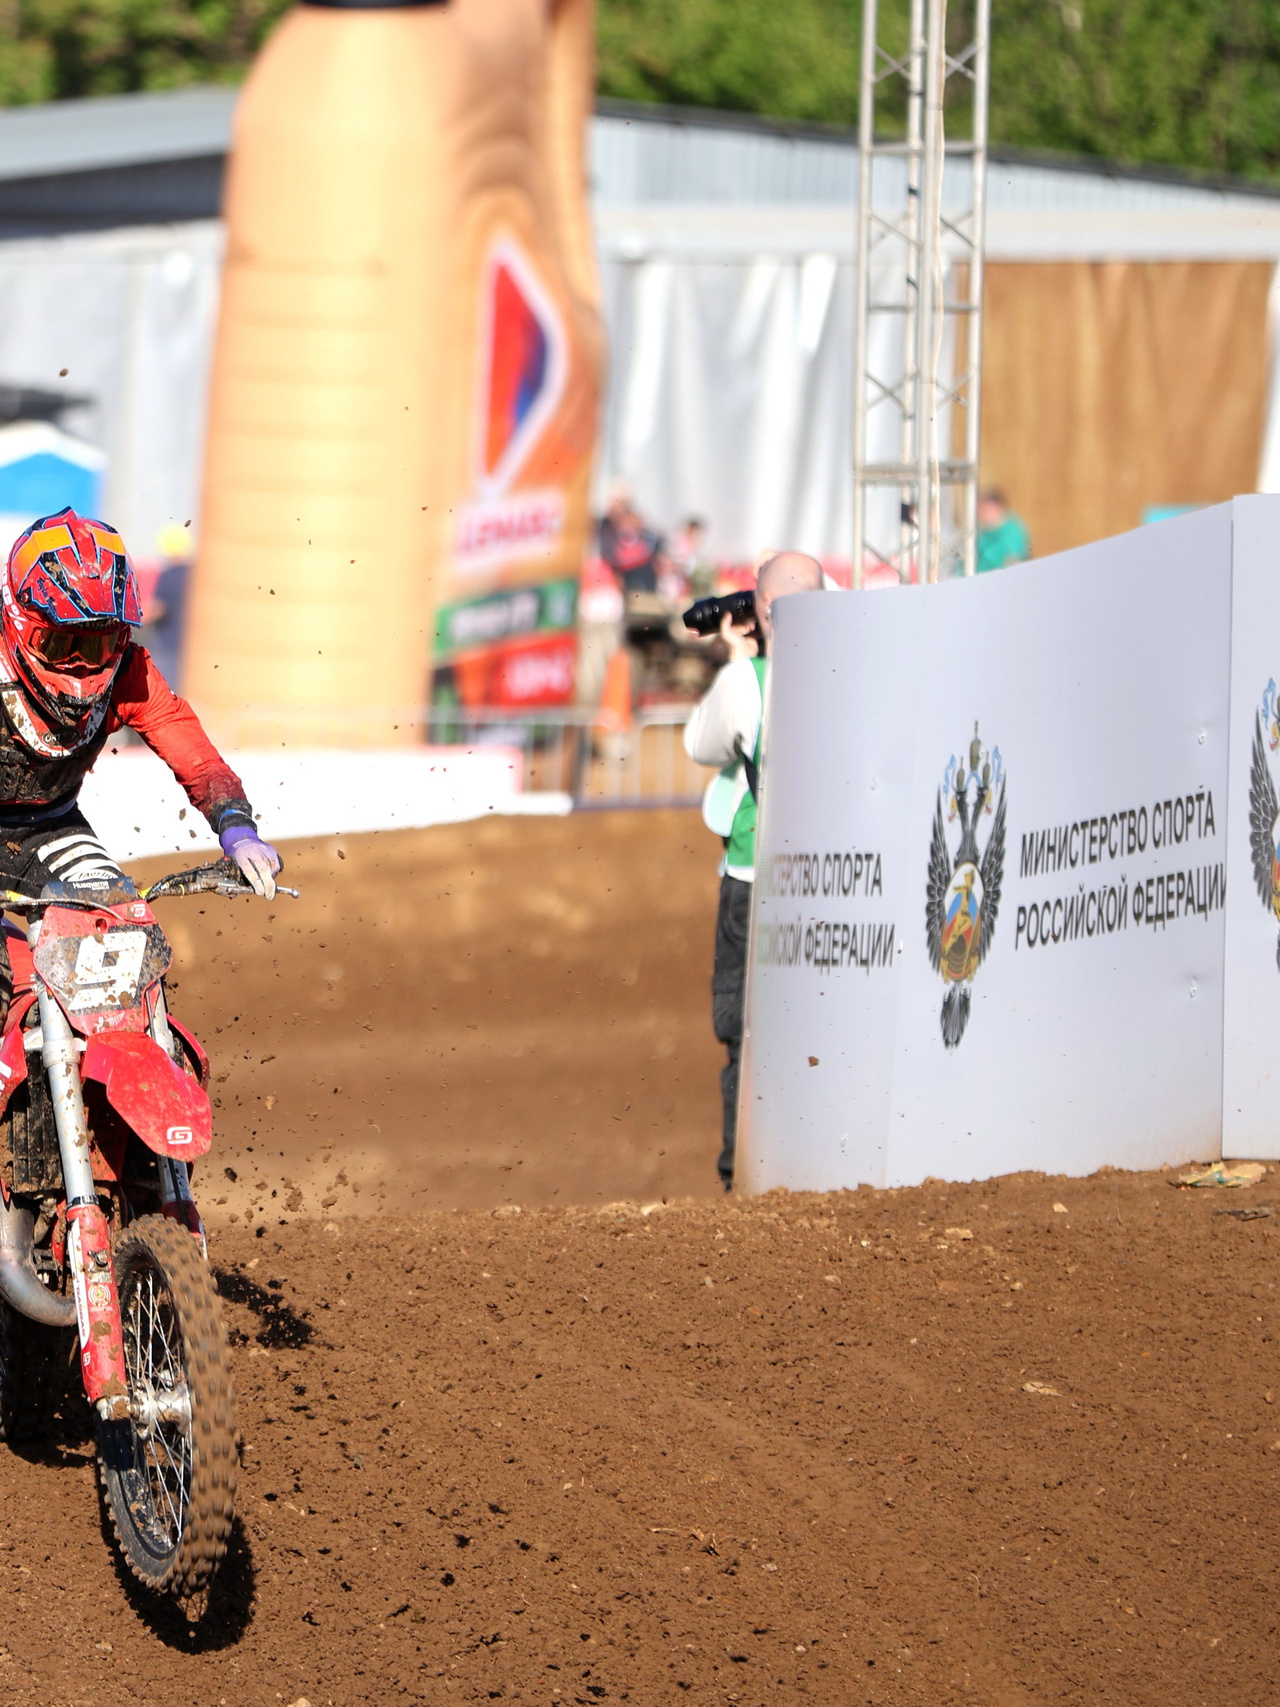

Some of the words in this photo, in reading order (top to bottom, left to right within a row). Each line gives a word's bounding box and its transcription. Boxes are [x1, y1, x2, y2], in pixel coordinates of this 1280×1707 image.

[1020, 806, 1148, 879] МИНИСТЕРСТВО
[1152, 791, 1215, 849] СПОРТА
[823, 853, 883, 897] СПОРТА
[1015, 873, 1128, 951] РОССИЙСКОЙ
[68, 931, 147, 1010] 9
[805, 923, 895, 976] ФЕДЕРАЦИИ
